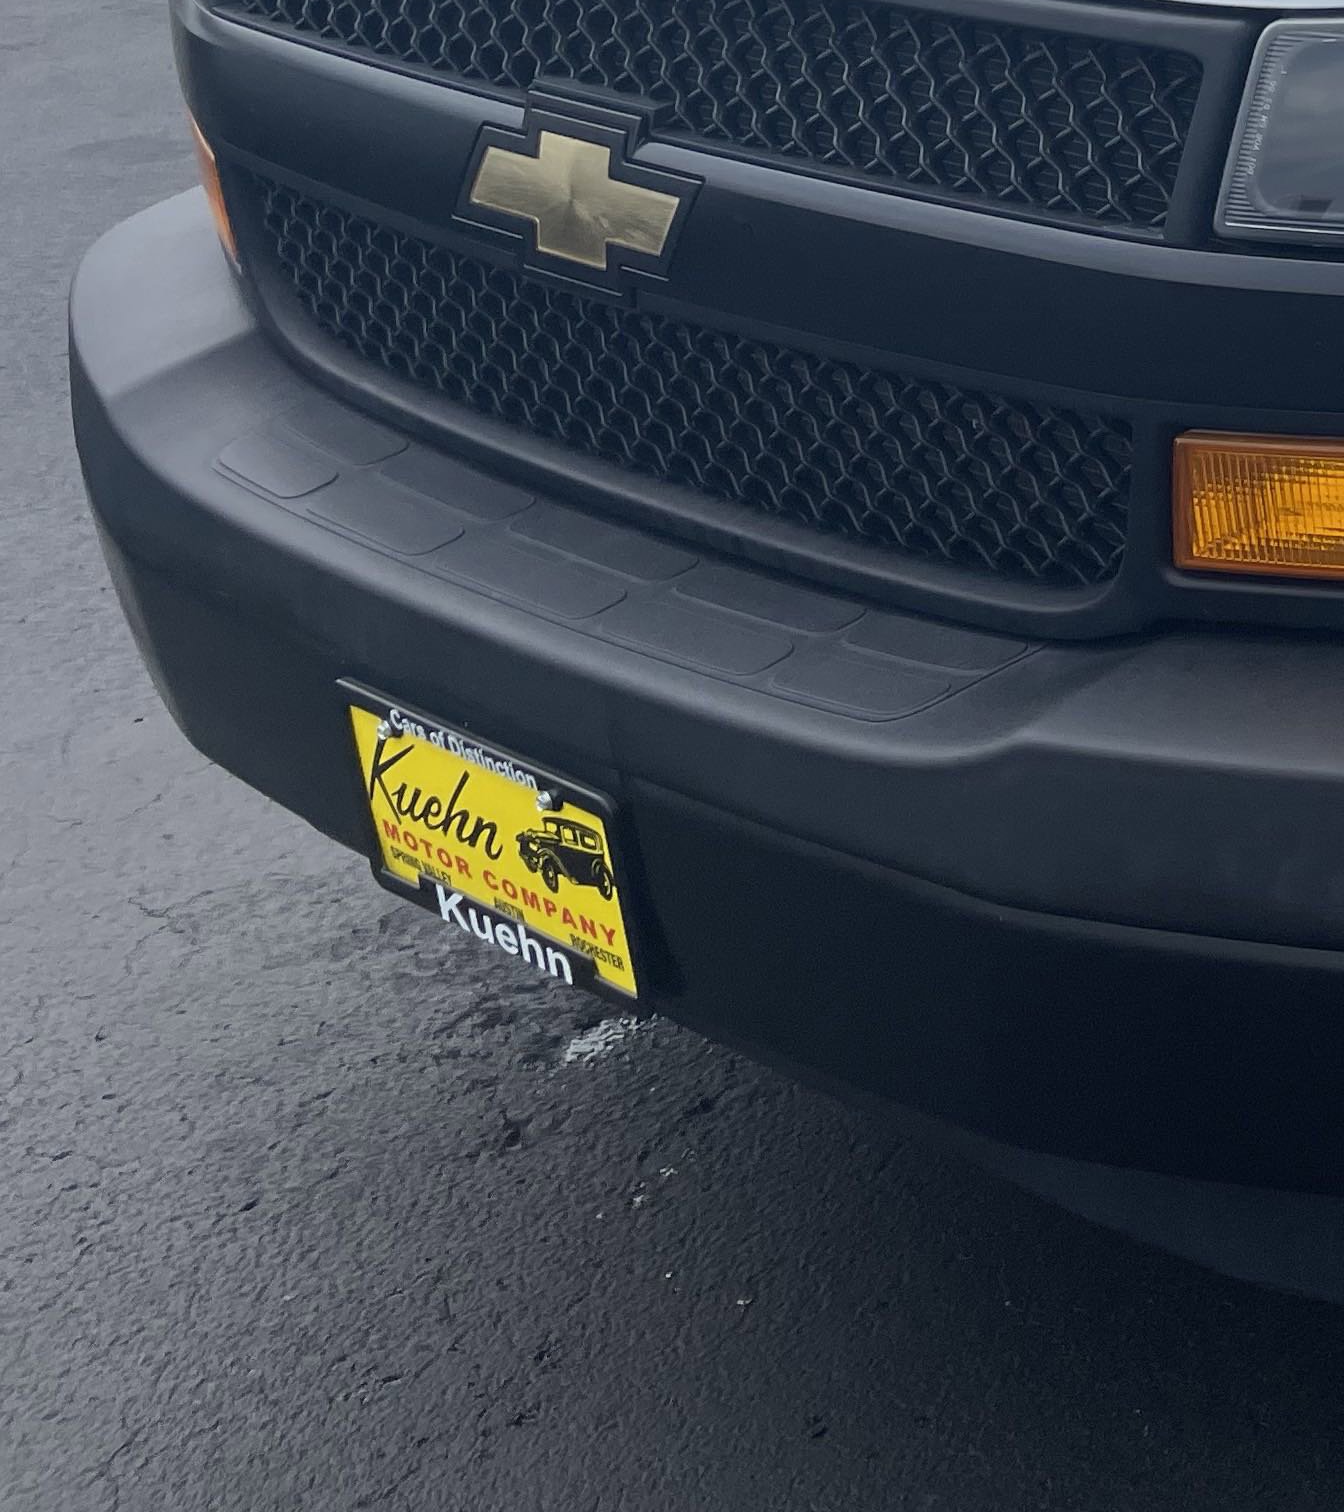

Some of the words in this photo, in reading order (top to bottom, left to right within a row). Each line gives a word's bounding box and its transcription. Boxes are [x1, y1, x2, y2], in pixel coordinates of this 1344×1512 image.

[370, 737, 503, 861] Kuehn
[389, 708, 427, 741] Cars
[429, 731, 446, 750] of
[447, 734, 539, 791] Distinction
[382, 819, 473, 880] MOTOR
[482, 869, 617, 947] COMPANY
[435, 884, 574, 986] Kuehn
